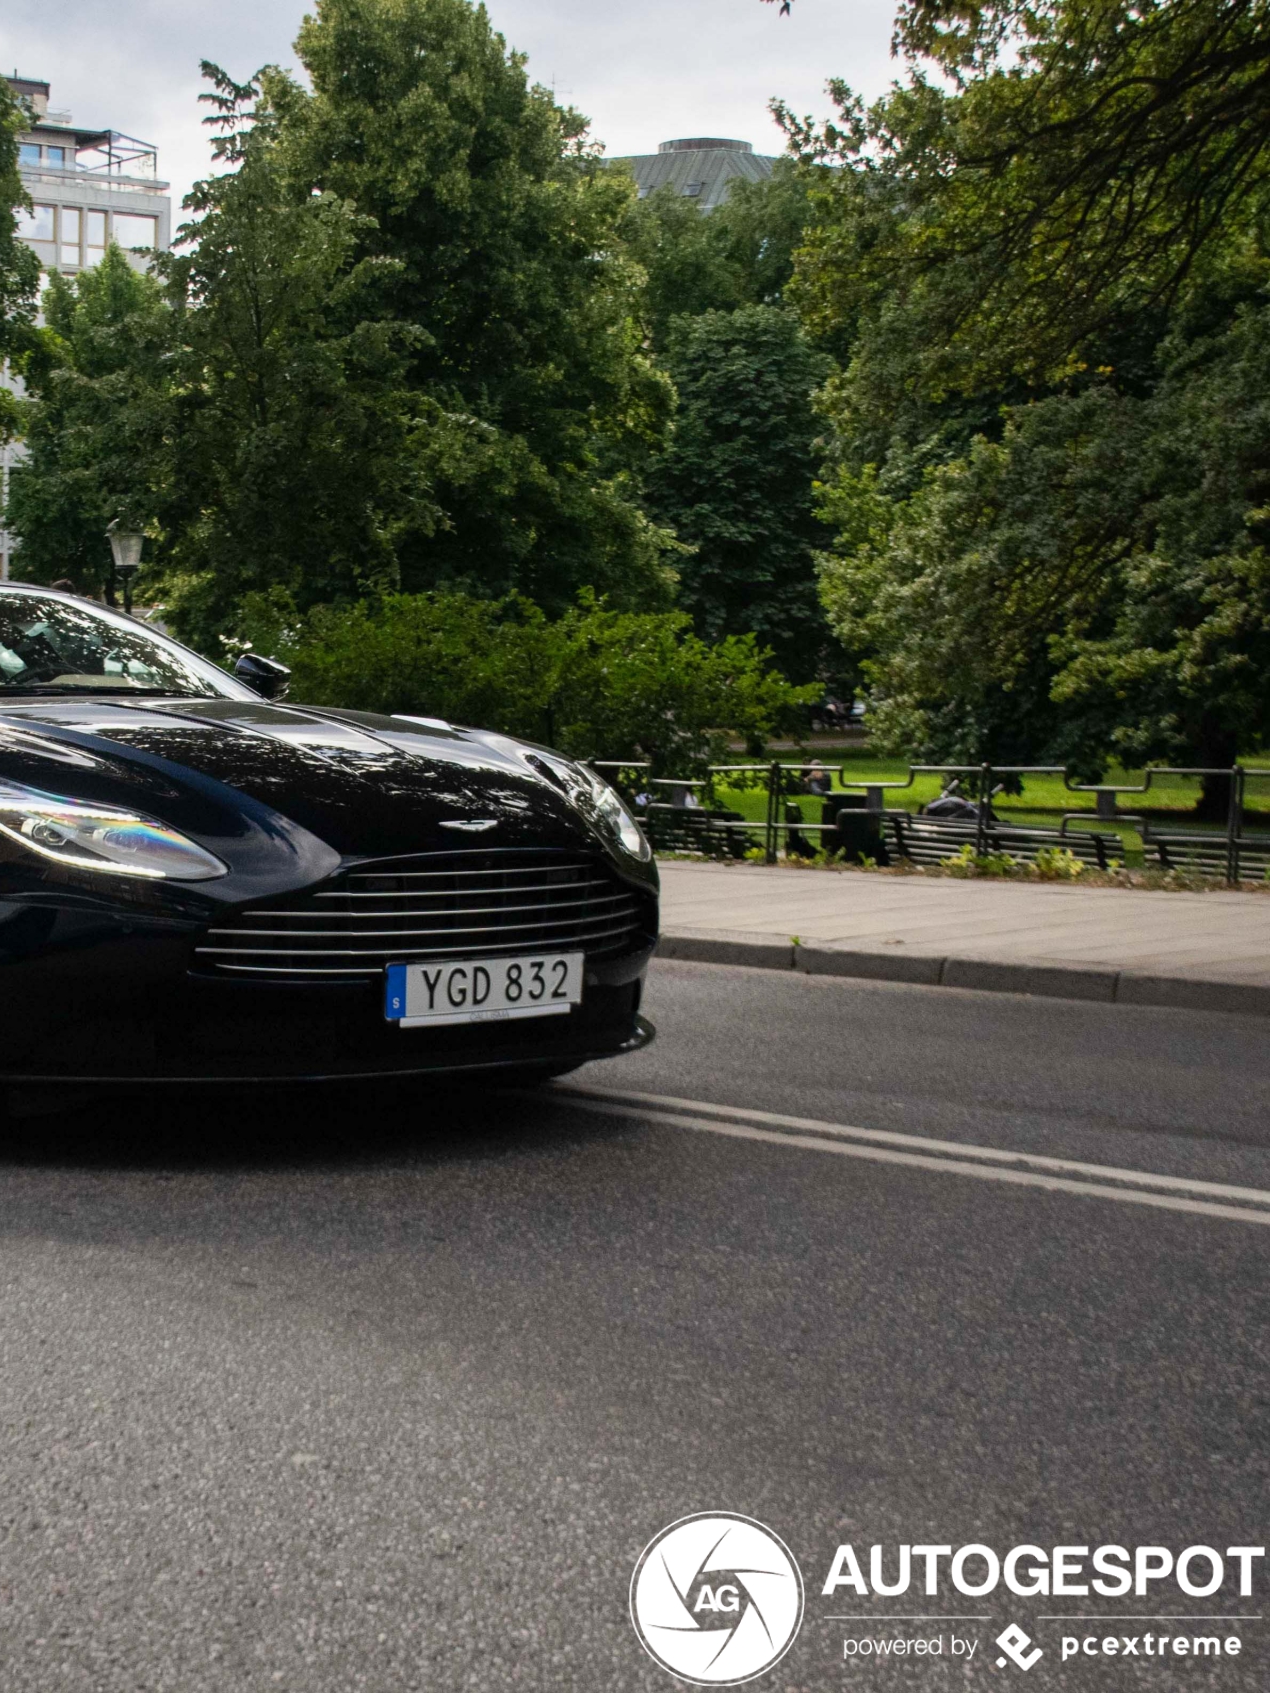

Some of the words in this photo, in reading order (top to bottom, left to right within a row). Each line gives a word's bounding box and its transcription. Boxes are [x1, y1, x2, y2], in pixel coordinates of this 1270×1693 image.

[422, 967, 491, 1010] YGD
[505, 959, 568, 1002] 832
[392, 997, 400, 1009] S
